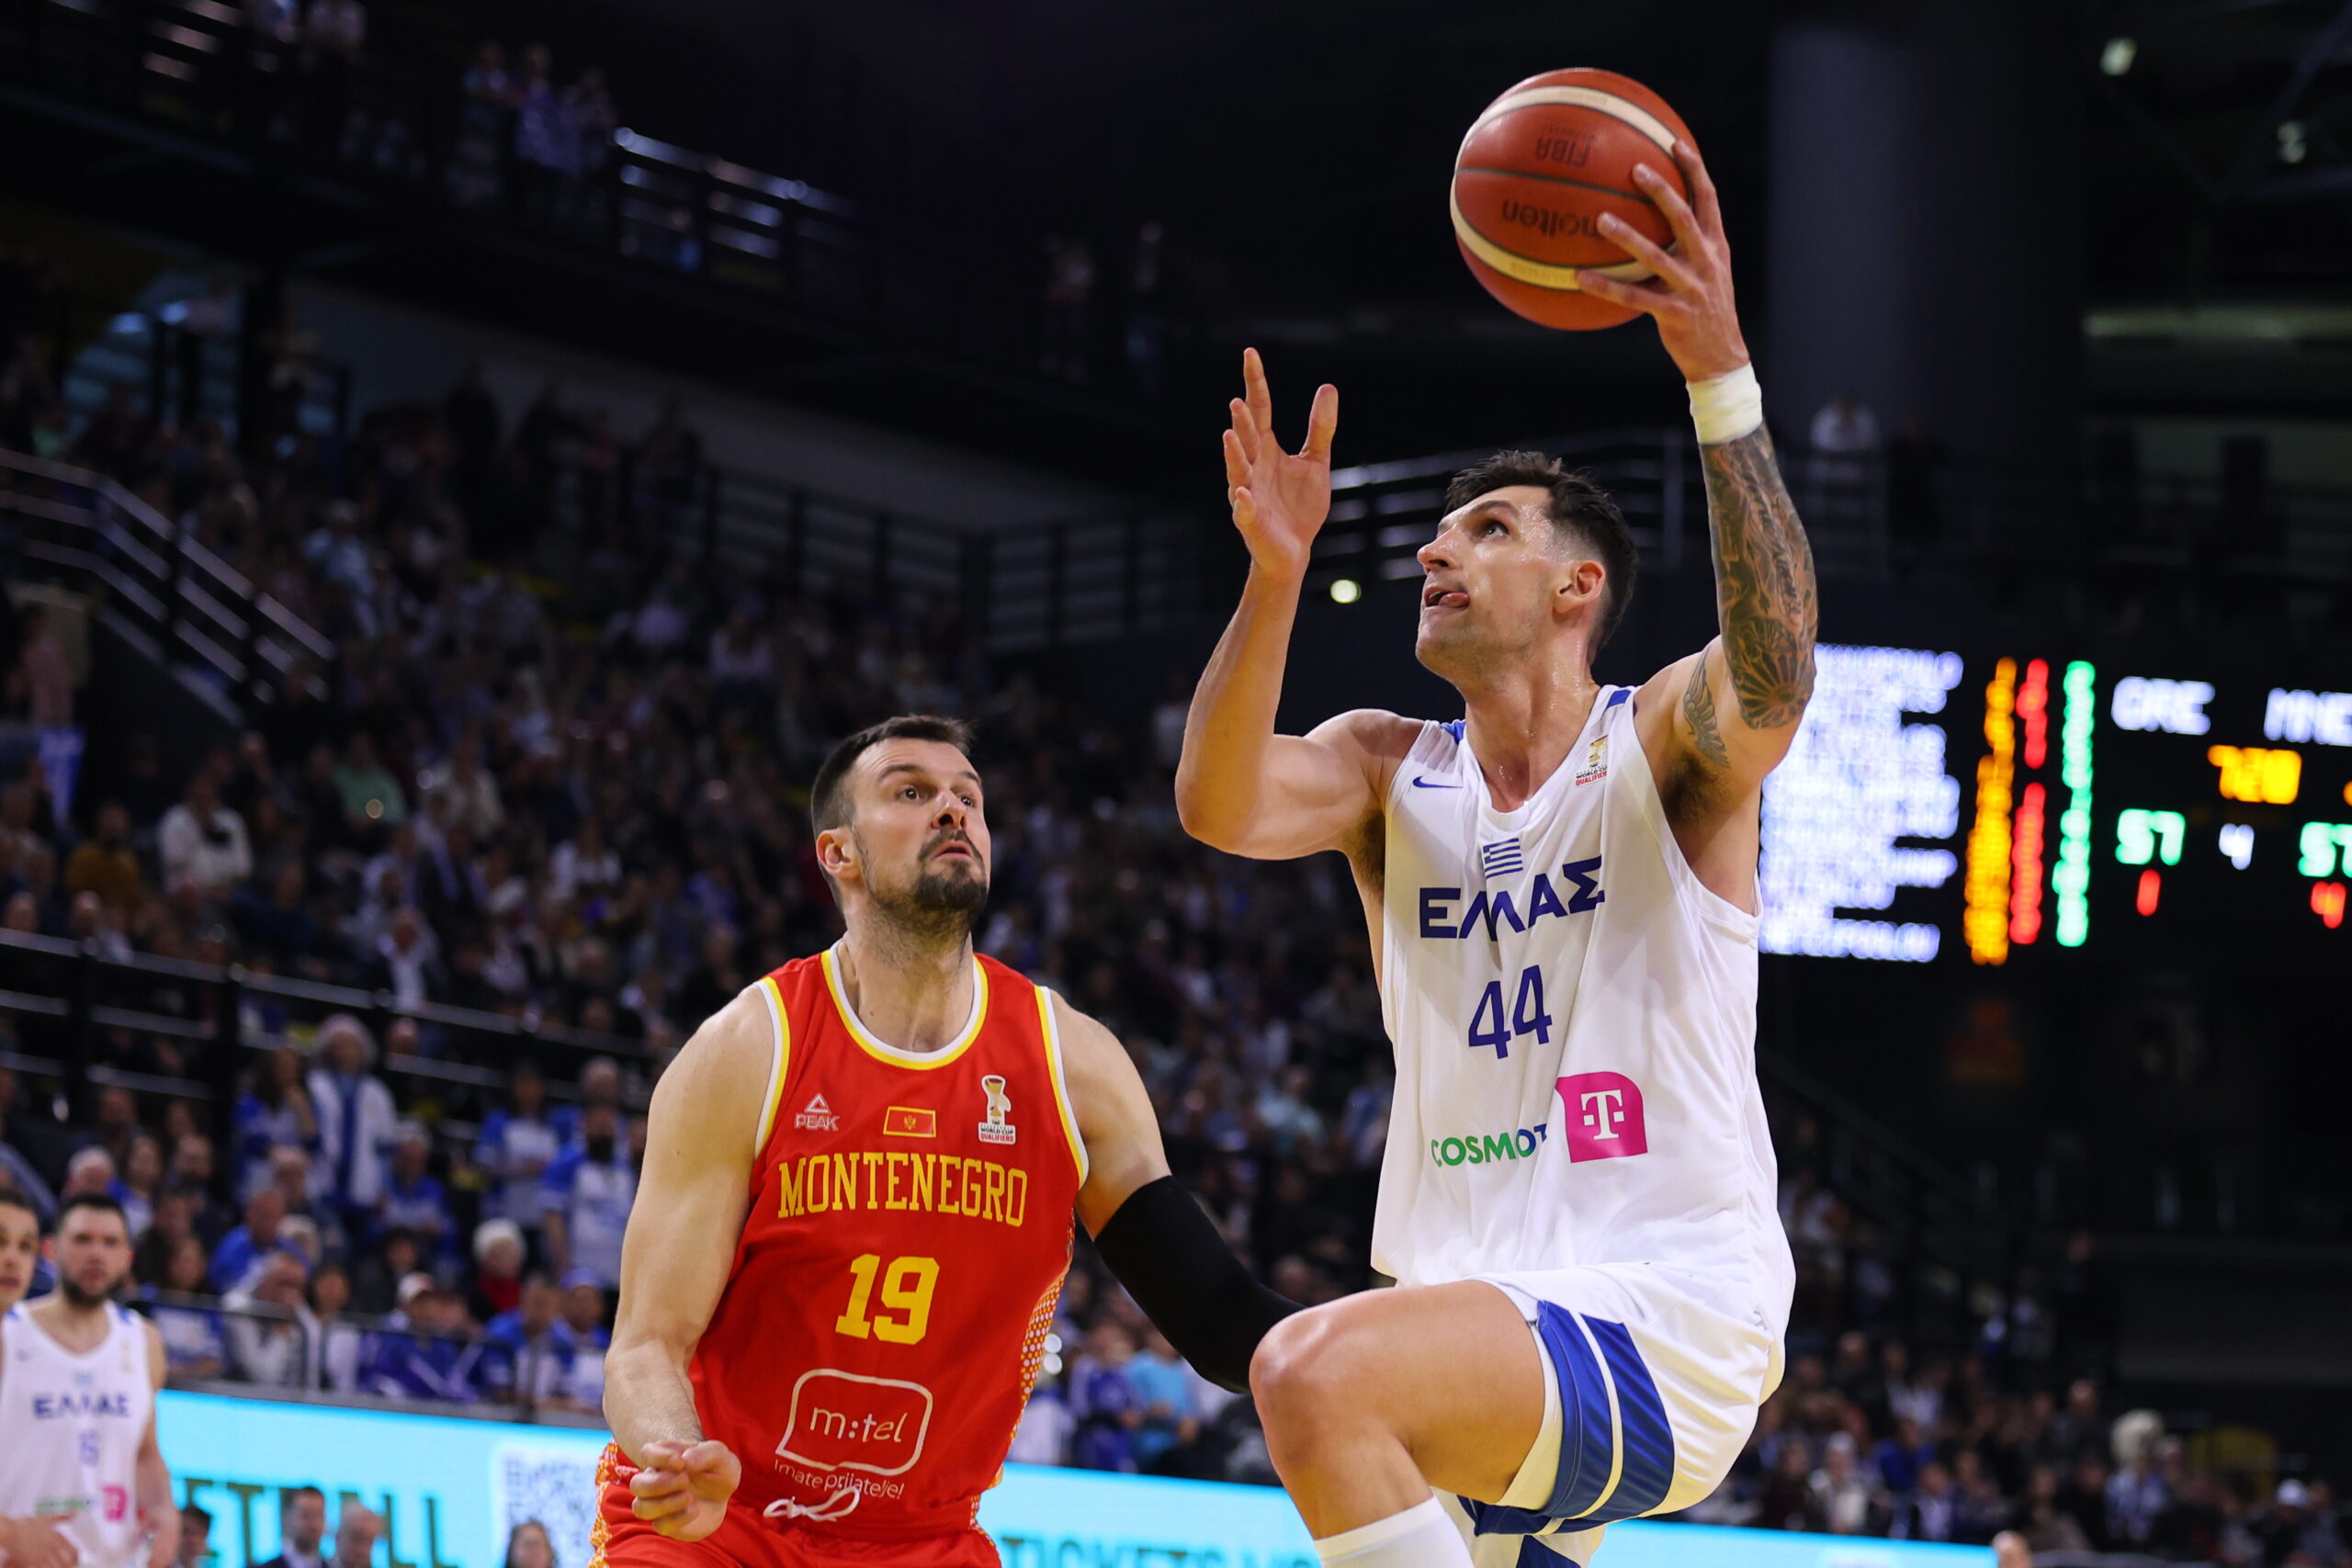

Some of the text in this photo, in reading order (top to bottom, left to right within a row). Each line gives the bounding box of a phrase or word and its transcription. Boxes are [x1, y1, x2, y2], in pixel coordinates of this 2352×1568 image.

[1576, 771, 1607, 785] QUALIFIER
[2115, 808, 2186, 865] 57
[1468, 964, 1553, 1060] 44
[794, 1112, 840, 1131] PEAK
[980, 1134, 1014, 1142] QUALIFIERS
[1430, 1122, 1547, 1168] COSMOT
[778, 1152, 1027, 1227] MONTENEGRO
[835, 1253, 940, 1346] 19
[809, 1406, 909, 1443] m:tel
[774, 1459, 823, 1489] Imate
